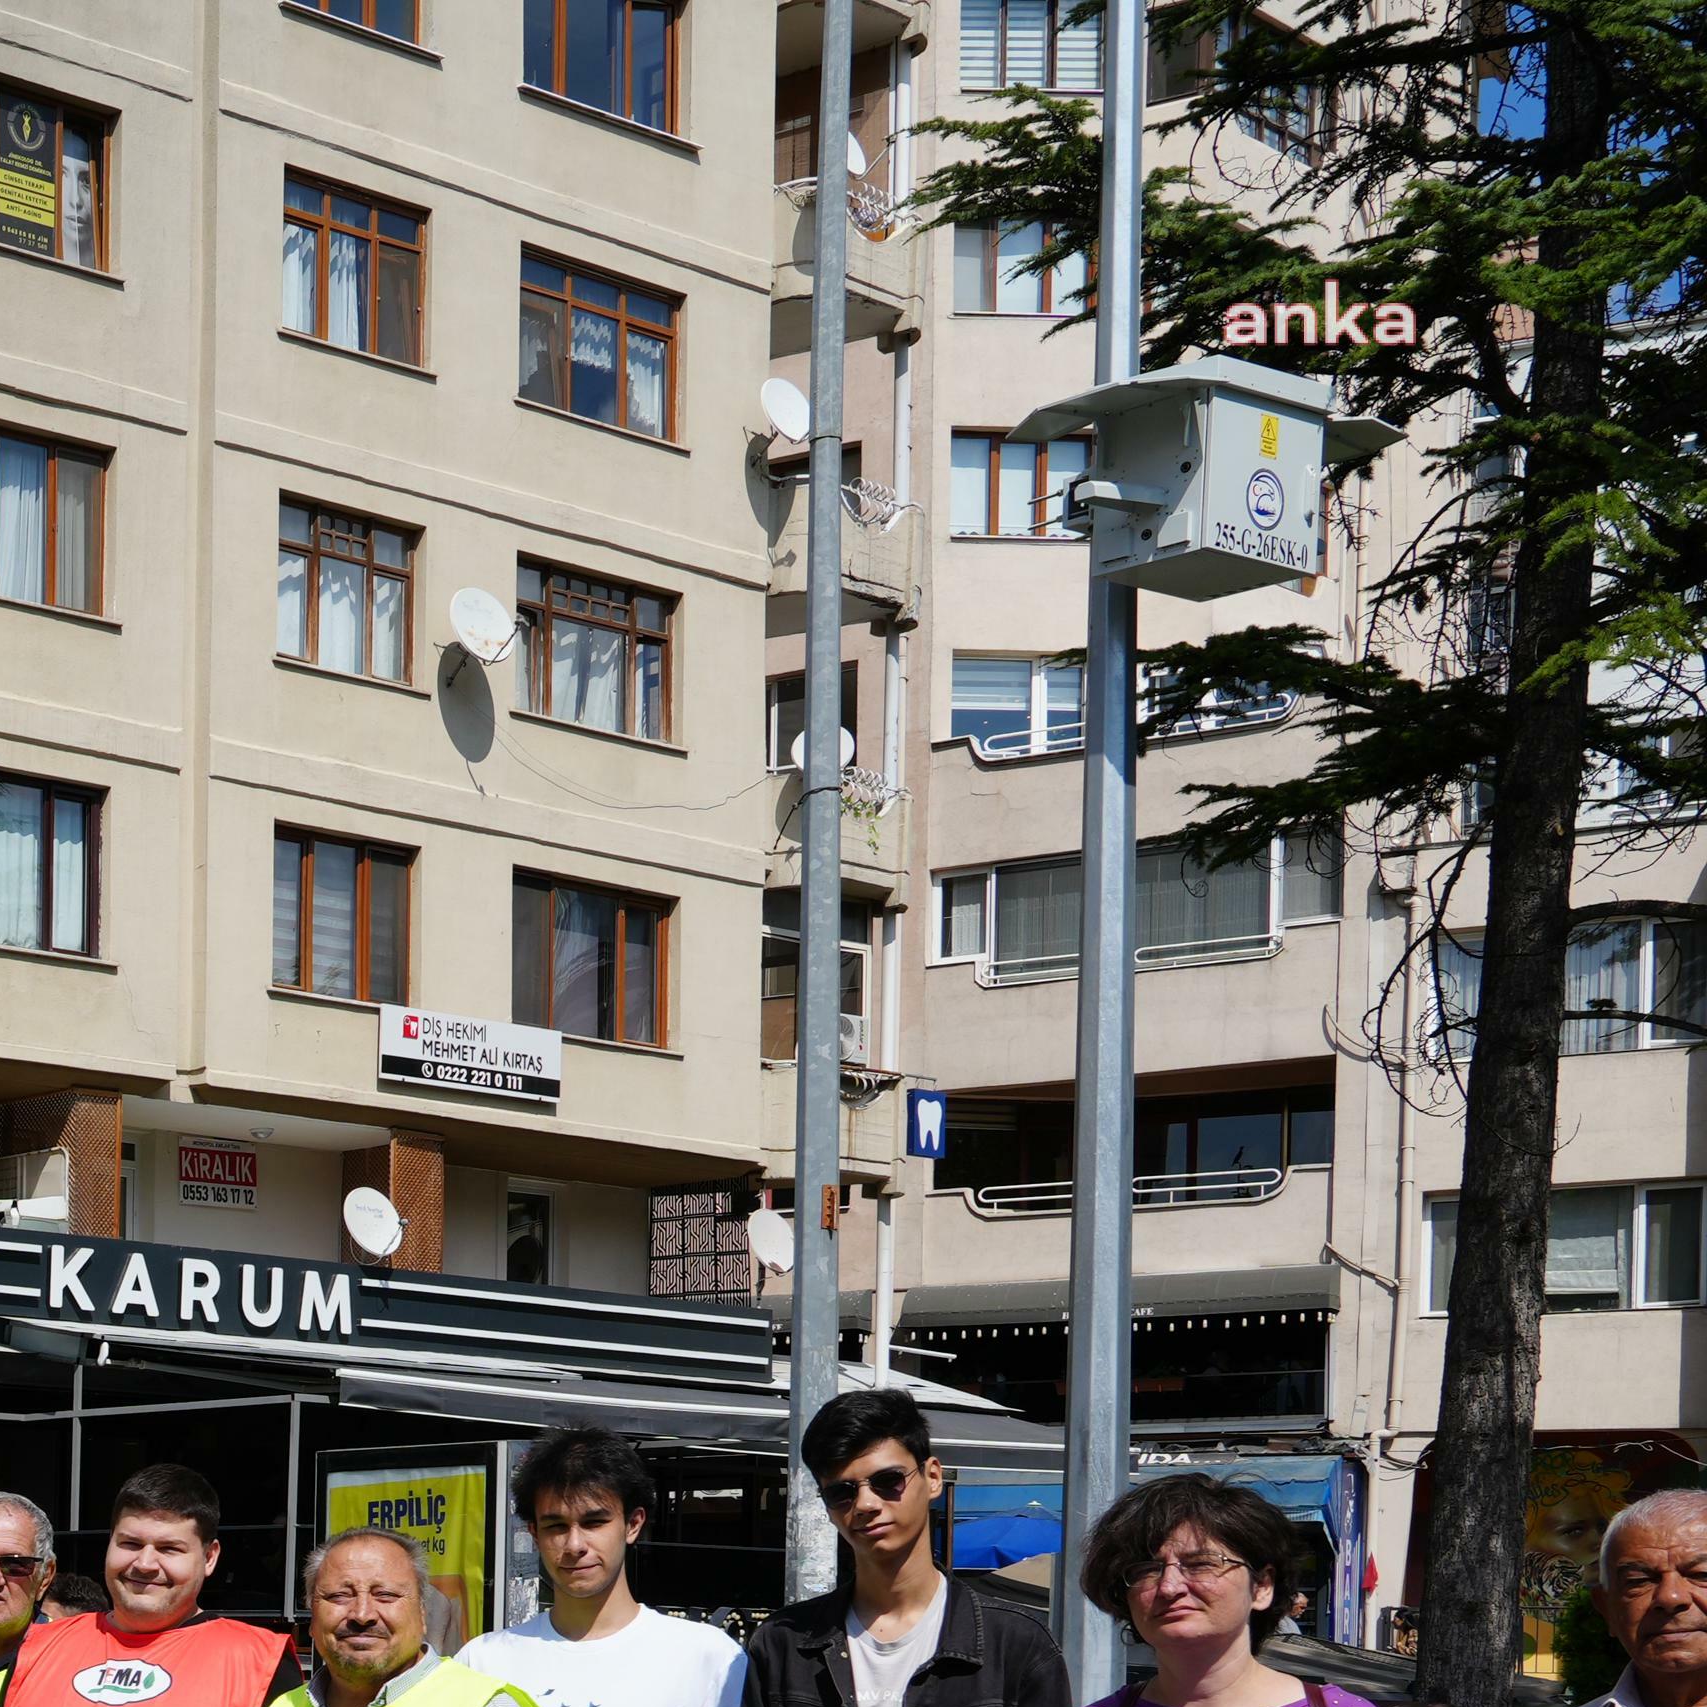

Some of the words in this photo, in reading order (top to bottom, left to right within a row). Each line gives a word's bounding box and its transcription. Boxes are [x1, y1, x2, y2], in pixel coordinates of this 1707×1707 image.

[1214, 521, 1309, 570] 255-G-26ESK-0
[422, 1017, 442, 1039] DİŞ
[446, 1022, 487, 1043] HEKİMİ
[422, 1039, 476, 1063] MEHMET
[479, 1047, 499, 1066] ALİ
[503, 1051, 544, 1075] KIRTAŞ
[437, 1065, 468, 1084] 0222
[470, 1069, 492, 1086] 221
[494, 1073, 503, 1088] 0
[505, 1074, 524, 1091] 111
[182, 1184, 209, 1202] 0553
[211, 1187, 228, 1203] 163
[230, 1188, 241, 1204] 17
[243, 1189, 255, 1205] 12
[49, 1244, 352, 1335] KARUM
[367, 1488, 447, 1534] ERPİLİÇ
[432, 1535, 445, 1555] kg
[98, 1666, 142, 1688] TEMA
